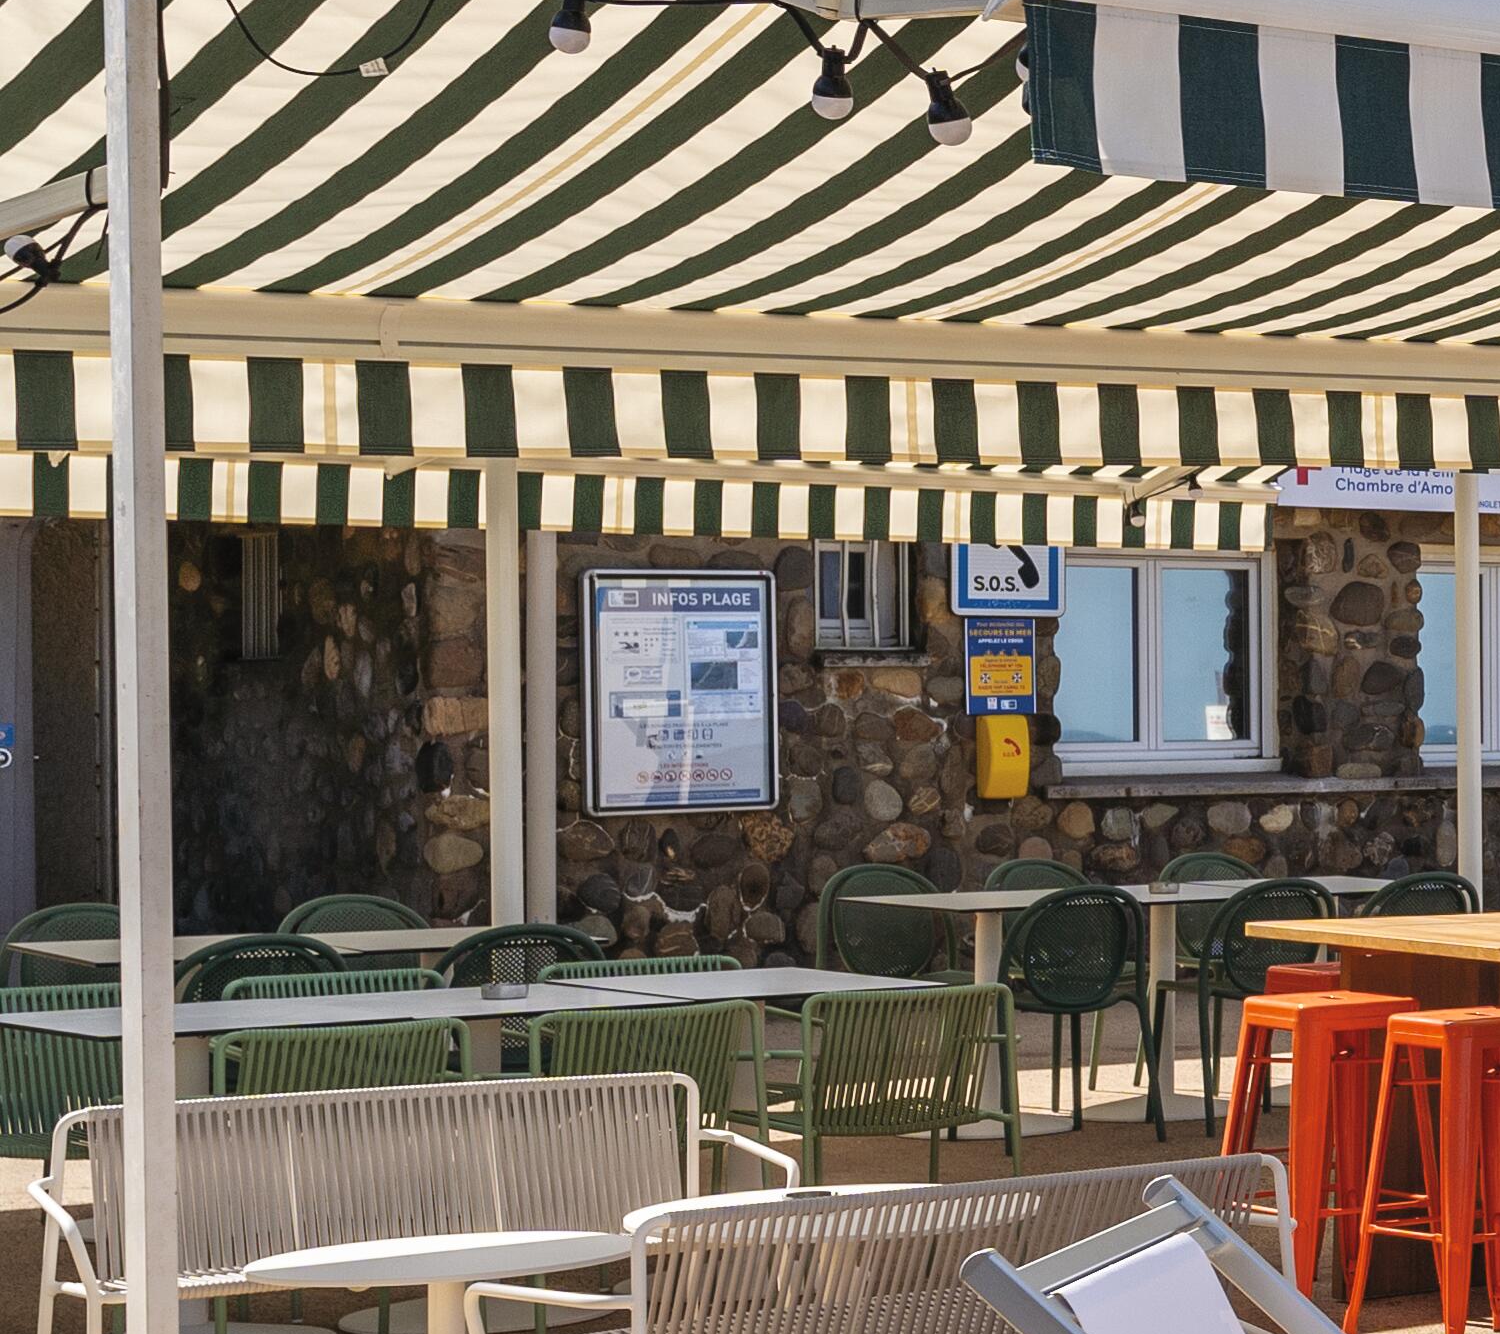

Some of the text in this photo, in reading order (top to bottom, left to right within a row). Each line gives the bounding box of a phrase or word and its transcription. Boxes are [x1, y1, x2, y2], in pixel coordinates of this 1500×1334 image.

[1335, 477, 1404, 494] Chambre
[974, 575, 1020, 592] S.O.S.
[652, 593, 751, 606] INFOS PLAGE
